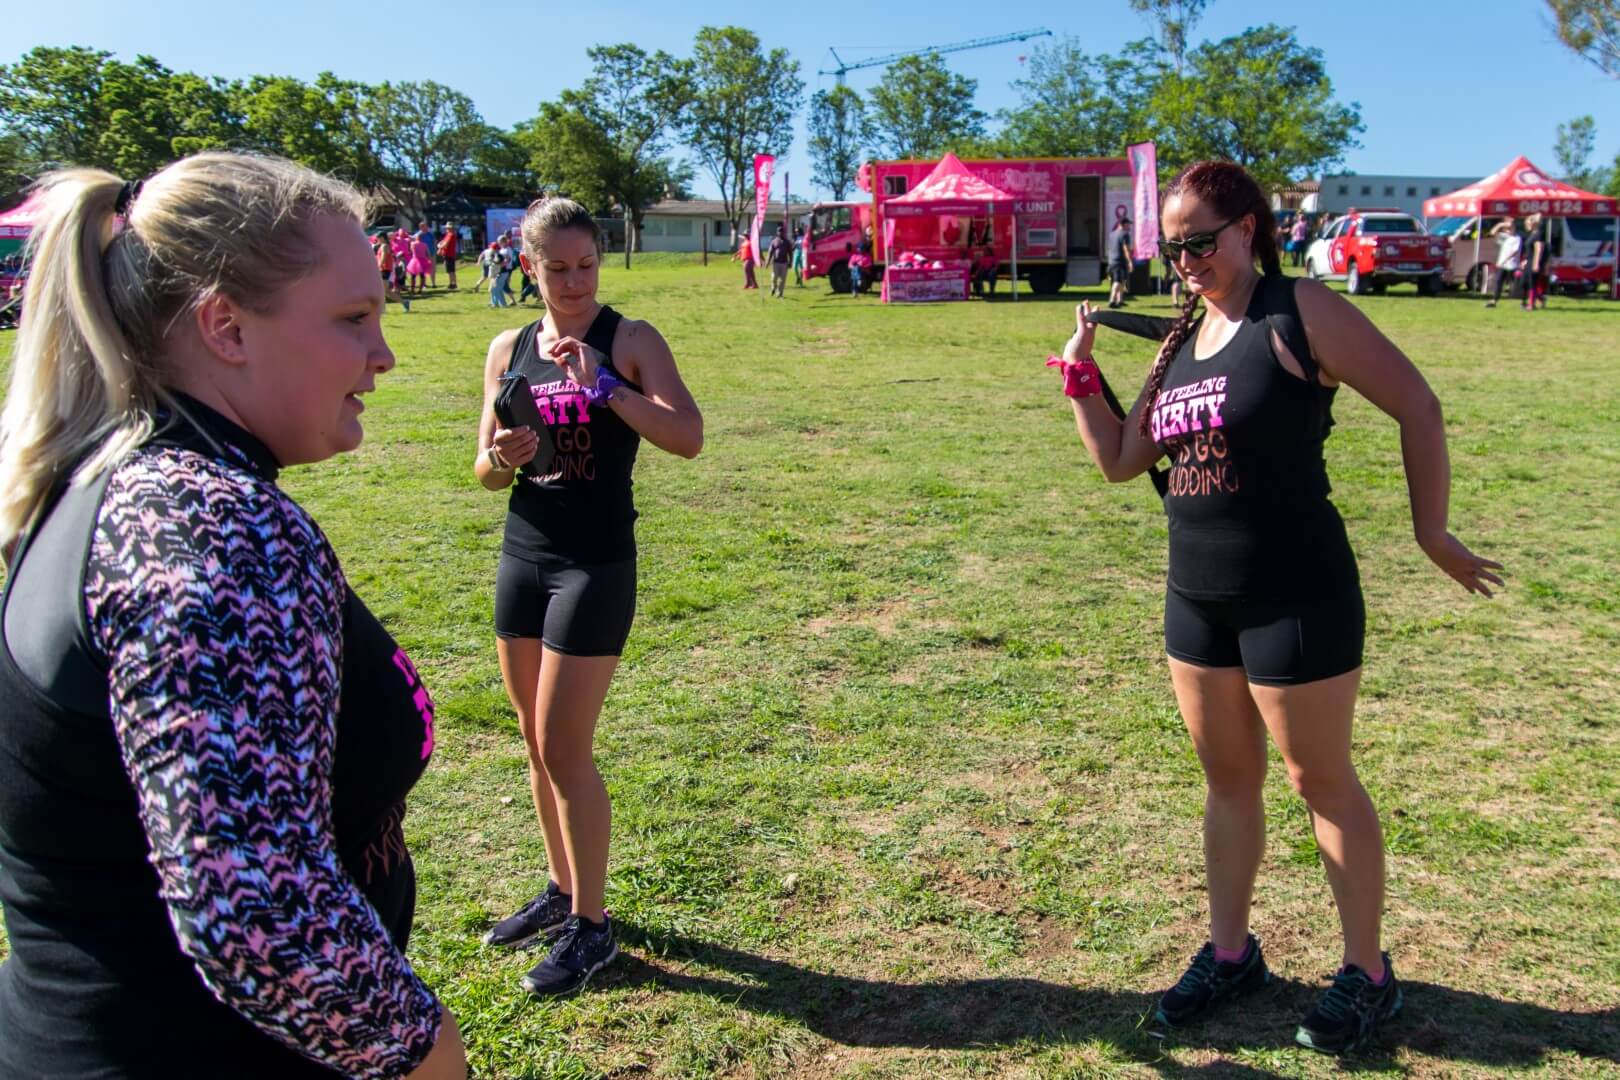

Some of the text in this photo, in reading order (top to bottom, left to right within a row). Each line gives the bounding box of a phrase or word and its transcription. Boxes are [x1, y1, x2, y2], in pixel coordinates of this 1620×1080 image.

[1026, 201, 1055, 212] UNIT
[1519, 201, 1582, 213] 084 124
[1168, 376, 1227, 402] FEELING
[535, 394, 591, 426] RTY
[1151, 393, 1226, 442] DIRTY
[556, 425, 592, 452] GO
[1194, 429, 1228, 462] GO
